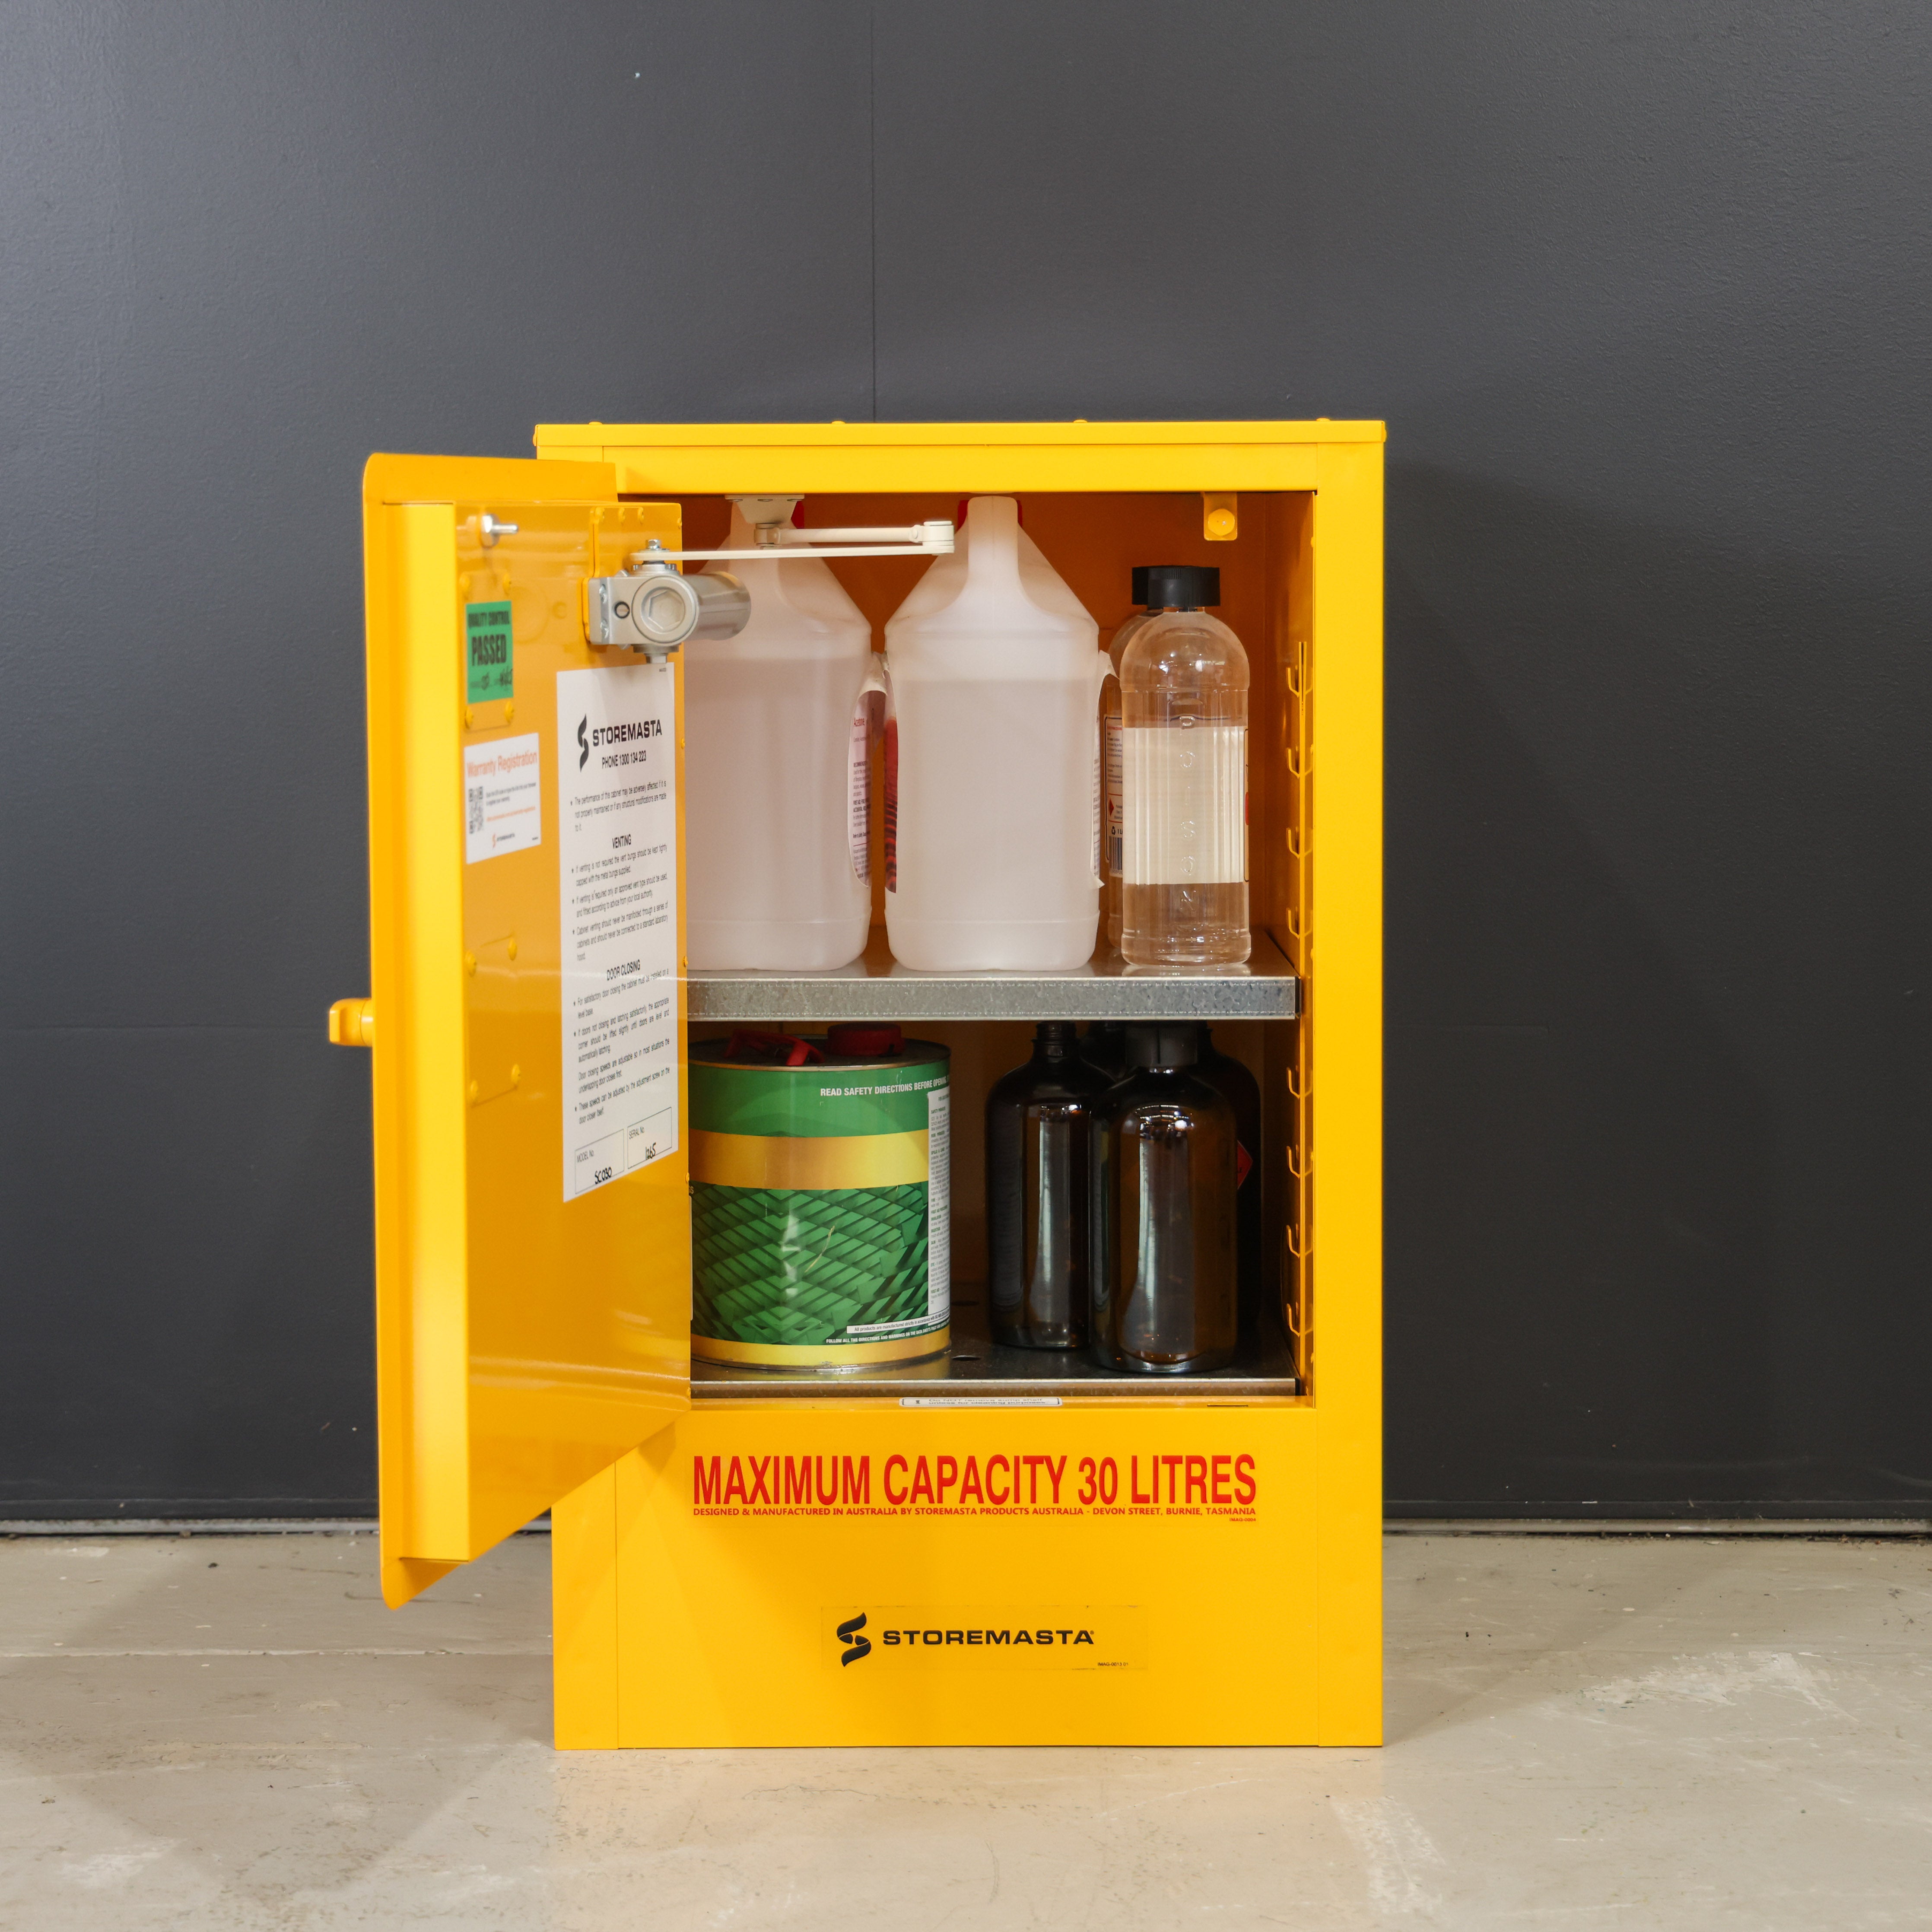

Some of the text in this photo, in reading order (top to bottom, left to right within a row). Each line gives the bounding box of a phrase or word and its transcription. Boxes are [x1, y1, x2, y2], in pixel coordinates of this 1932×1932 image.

[471, 634, 507, 667] PASSED
[853, 718, 865, 727] Acetone
[592, 719, 662, 747] STOREMASTA
[467, 749, 538, 778] Warranty Registration
[601, 754, 618, 769] PHONE
[619, 753, 629, 766] 1300
[630, 752, 638, 763] 134
[601, 791, 604, 800] of
[610, 789, 621, 798] cabinet
[647, 782, 658, 791] affected
[612, 833, 632, 849] VENTING
[607, 959, 640, 981] DOOR CLOSING
[820, 1088, 842, 1096] READ
[844, 1086, 873, 1096] SAFETY
[874, 1083, 913, 1094] DIRECTIONS
[914, 1080, 933, 1090] BEFORE
[629, 1128, 639, 1140] SERIAL
[576, 1151, 589, 1163] MODEL
[594, 1166, 612, 1185] SC030
[693, 1454, 1256, 1506] MAXIMUM CAPACITY 30 LITRES
[1128, 1507, 1163, 1516] STREET,
[1166, 1507, 1203, 1516] BURNIE,
